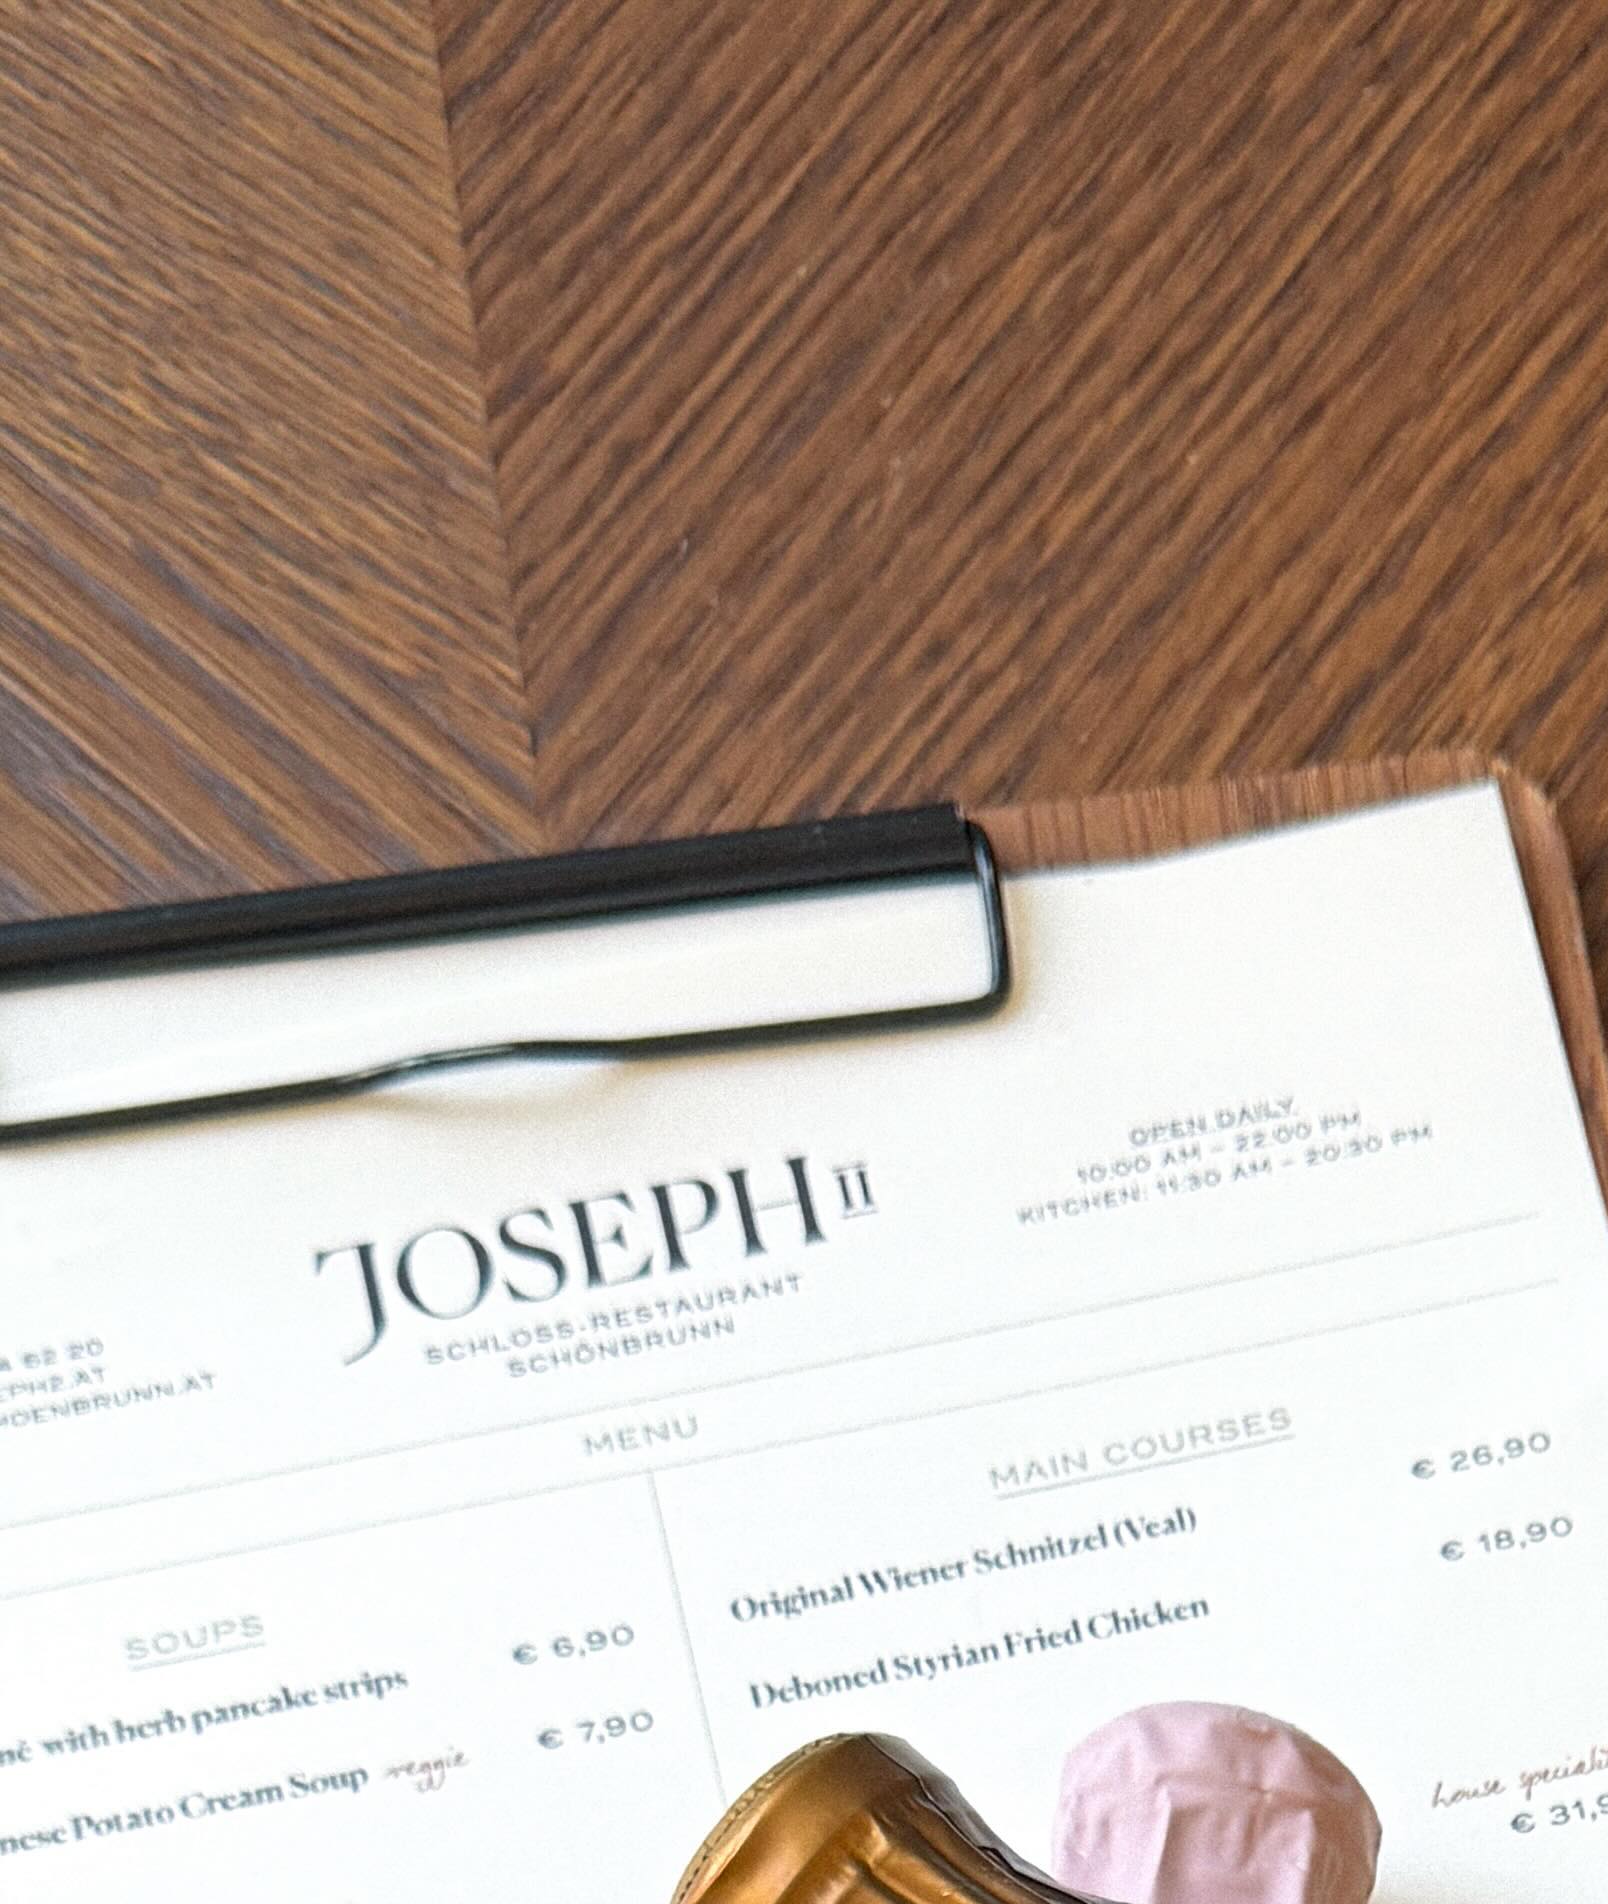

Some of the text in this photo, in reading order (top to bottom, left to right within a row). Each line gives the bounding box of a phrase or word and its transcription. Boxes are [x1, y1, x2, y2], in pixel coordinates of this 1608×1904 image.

[1128, 1116, 1207, 1147] OPEN
[1162, 1143, 1201, 1167] AM
[1231, 1157, 1272, 1181] AM
[315, 1156, 825, 1364] JOSEPH
[423, 1272, 802, 1365] SCHLOSS-RESTAURANT
[506, 1316, 735, 1378] SCHÖNBRUNN
[582, 1415, 698, 1456] MENU
[988, 1406, 1292, 1490] MAIN COURSES
[730, 1431, 1551, 1621] Original Wiener Schnitzel (Veal) 26,90
[124, 1614, 264, 1660] SOUPS
[750, 1516, 1573, 1708] Deboned Styrian Fried Chicken 18,90
[40, 1724, 110, 1755] with
[111, 1709, 186, 1744] herb
[191, 1686, 317, 1735] pancake
[323, 1671, 408, 1703] strips
[550, 1623, 634, 1658] 6,90
[69, 1709, 654, 1841] Potato Cream Soup veggie 7,90
[1431, 1779, 1506, 1808] house
